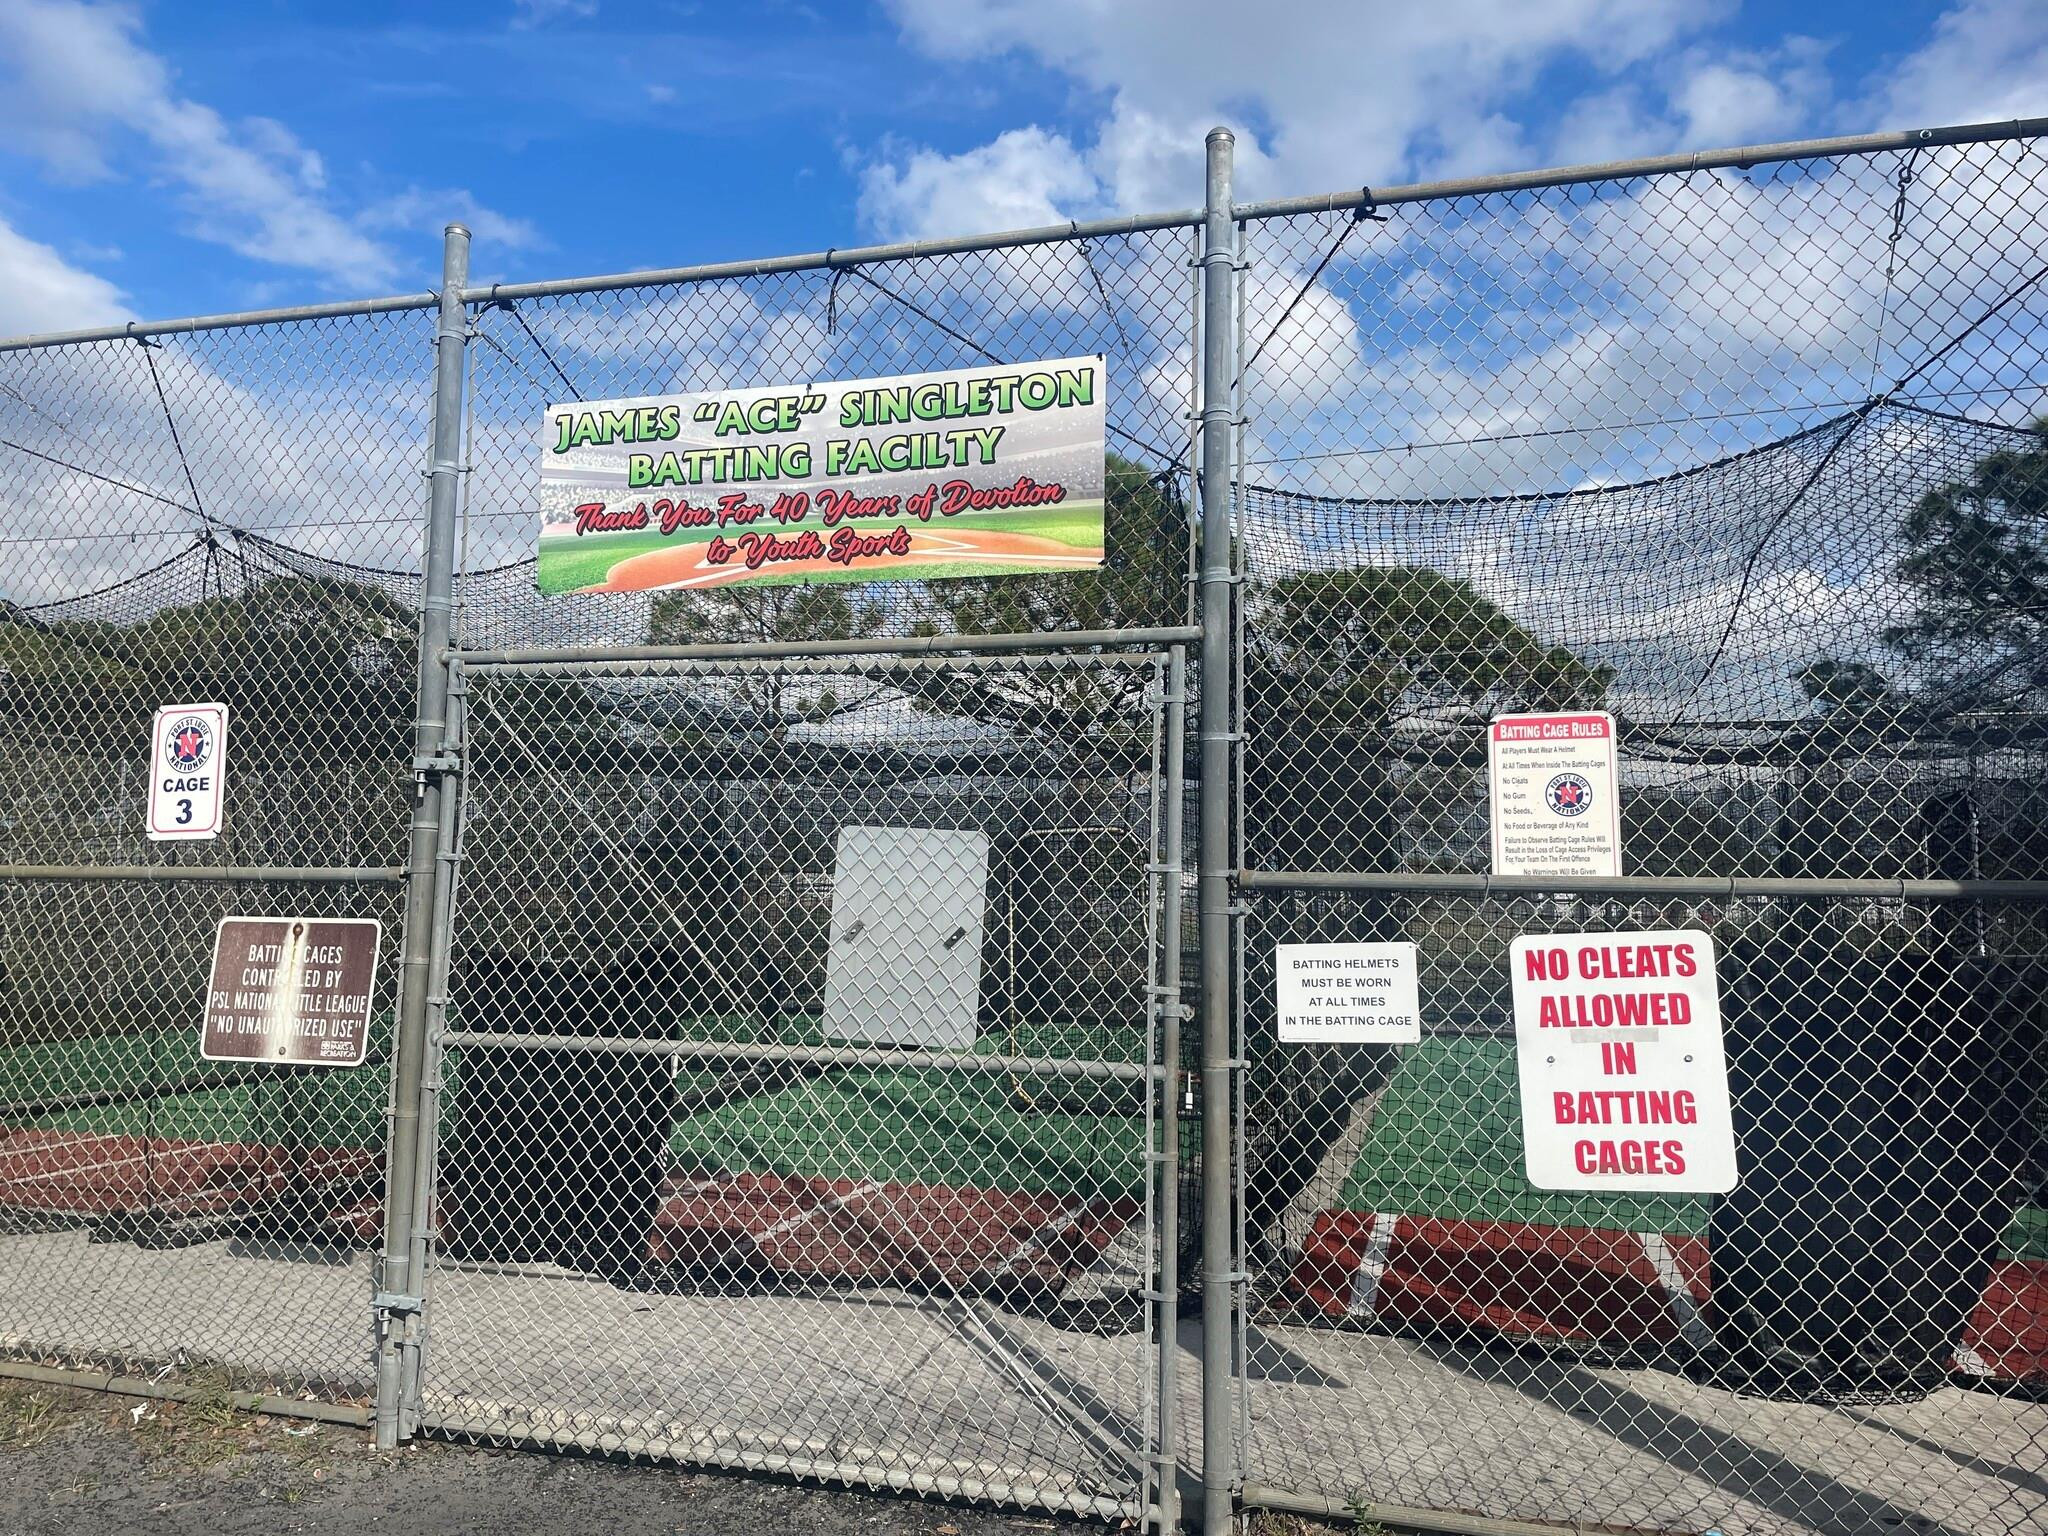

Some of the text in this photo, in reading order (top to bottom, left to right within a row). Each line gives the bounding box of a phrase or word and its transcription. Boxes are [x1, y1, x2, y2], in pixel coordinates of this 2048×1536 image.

[554, 405, 680, 454] JAMES
[840, 368, 1094, 429] SINGLETON
[629, 425, 1005, 488] BATTING FACILTY
[575, 475, 1069, 536] Thank You For 40 Years of Devotion
[706, 526, 911, 570] to Youth Sports
[1500, 722, 1603, 739] BATTING CAGE RULES
[179, 733, 199, 757] N
[1509, 748, 1526, 756] Players
[170, 754, 207, 771] NATIONAL
[1572, 760, 1590, 768] Batting
[1590, 760, 1606, 768] Cages
[163, 777, 210, 792] CAGE
[1560, 786, 1578, 804] N
[176, 799, 192, 825] 3
[1552, 802, 1588, 814] NATIONAL
[1533, 822, 1558, 830] Beverage
[1565, 822, 1575, 830] Any
[1549, 836, 1566, 844] Batting
[1568, 836, 1580, 844] Cage
[1555, 846, 1568, 854] Cage
[1587, 845, 1611, 854] Privileges
[248, 944, 343, 964] BATTI CAGES
[1293, 958, 1400, 970] BATTING HELMETS
[1525, 944, 1697, 981] NO CLEATS
[242, 968, 343, 988] CONTRED BY
[1301, 978, 1392, 988] MUST BE WORN
[210, 990, 367, 1014] PSL NATIONA ITTLE LEAGUE
[1308, 996, 1386, 1006] AT ALL TIMES
[1539, 992, 1692, 1028] ALLOWED
[210, 1014, 362, 1038] "NO UNAURIZED USE"
[1285, 1016, 1412, 1026] IN THE BATTING CAGE
[1601, 1042, 1637, 1075] IN
[1553, 1090, 1698, 1124] BATTING
[1574, 1140, 1686, 1175] CAGES
